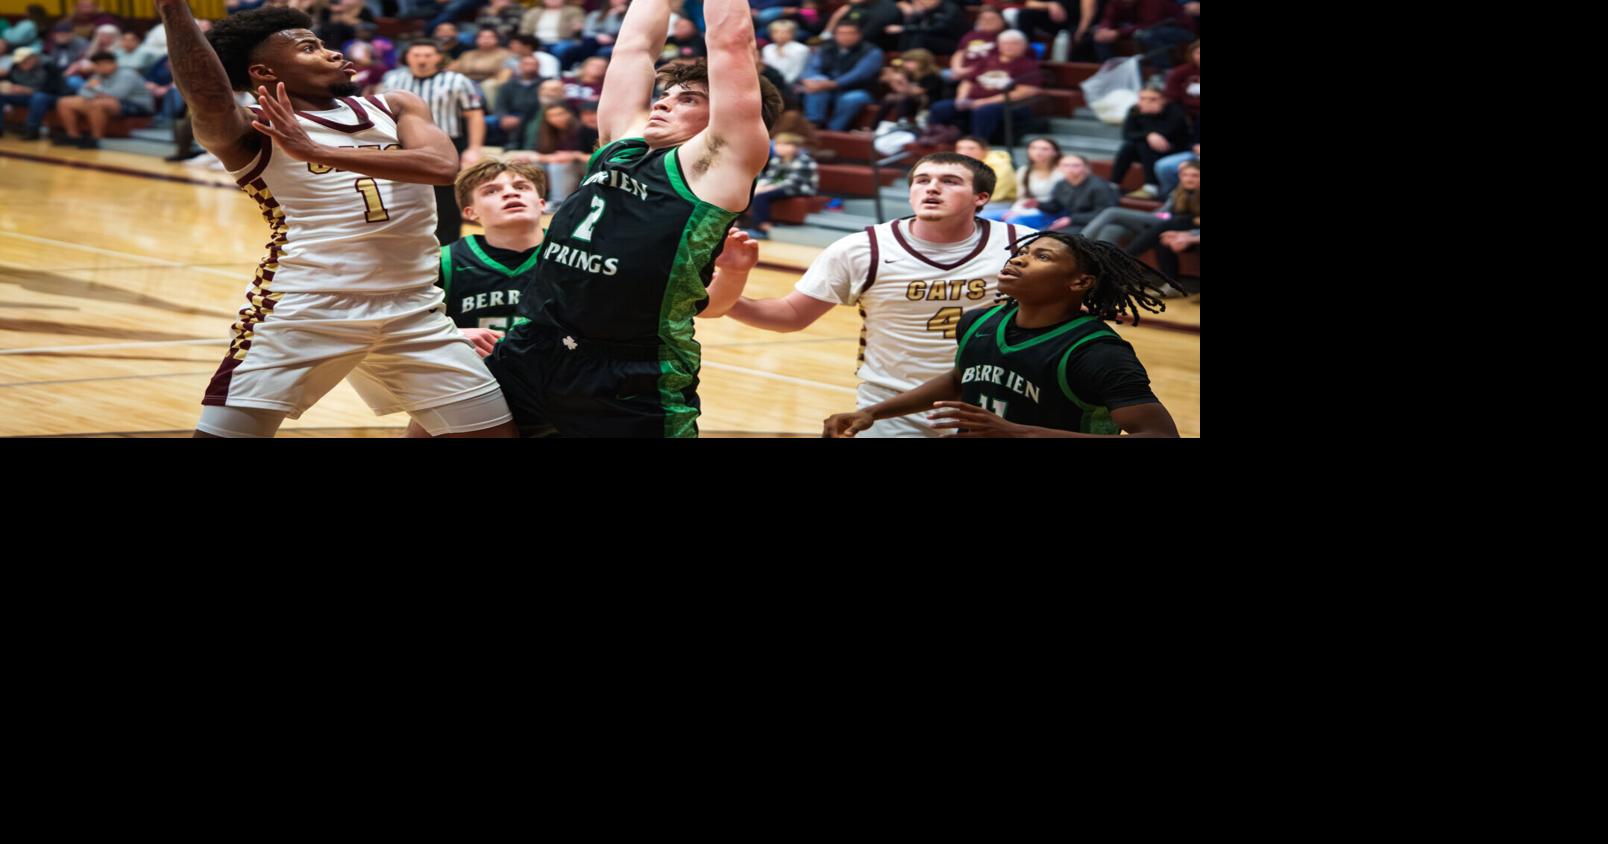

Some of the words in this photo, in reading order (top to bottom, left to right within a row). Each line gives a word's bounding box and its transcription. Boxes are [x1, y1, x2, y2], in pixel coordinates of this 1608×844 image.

[355, 177, 389, 223] 1
[571, 194, 605, 242] 2
[543, 242, 619, 276] PRINGS
[906, 279, 987, 301] CATS
[926, 306, 963, 339] 4
[961, 364, 1040, 404] BERRIEN
